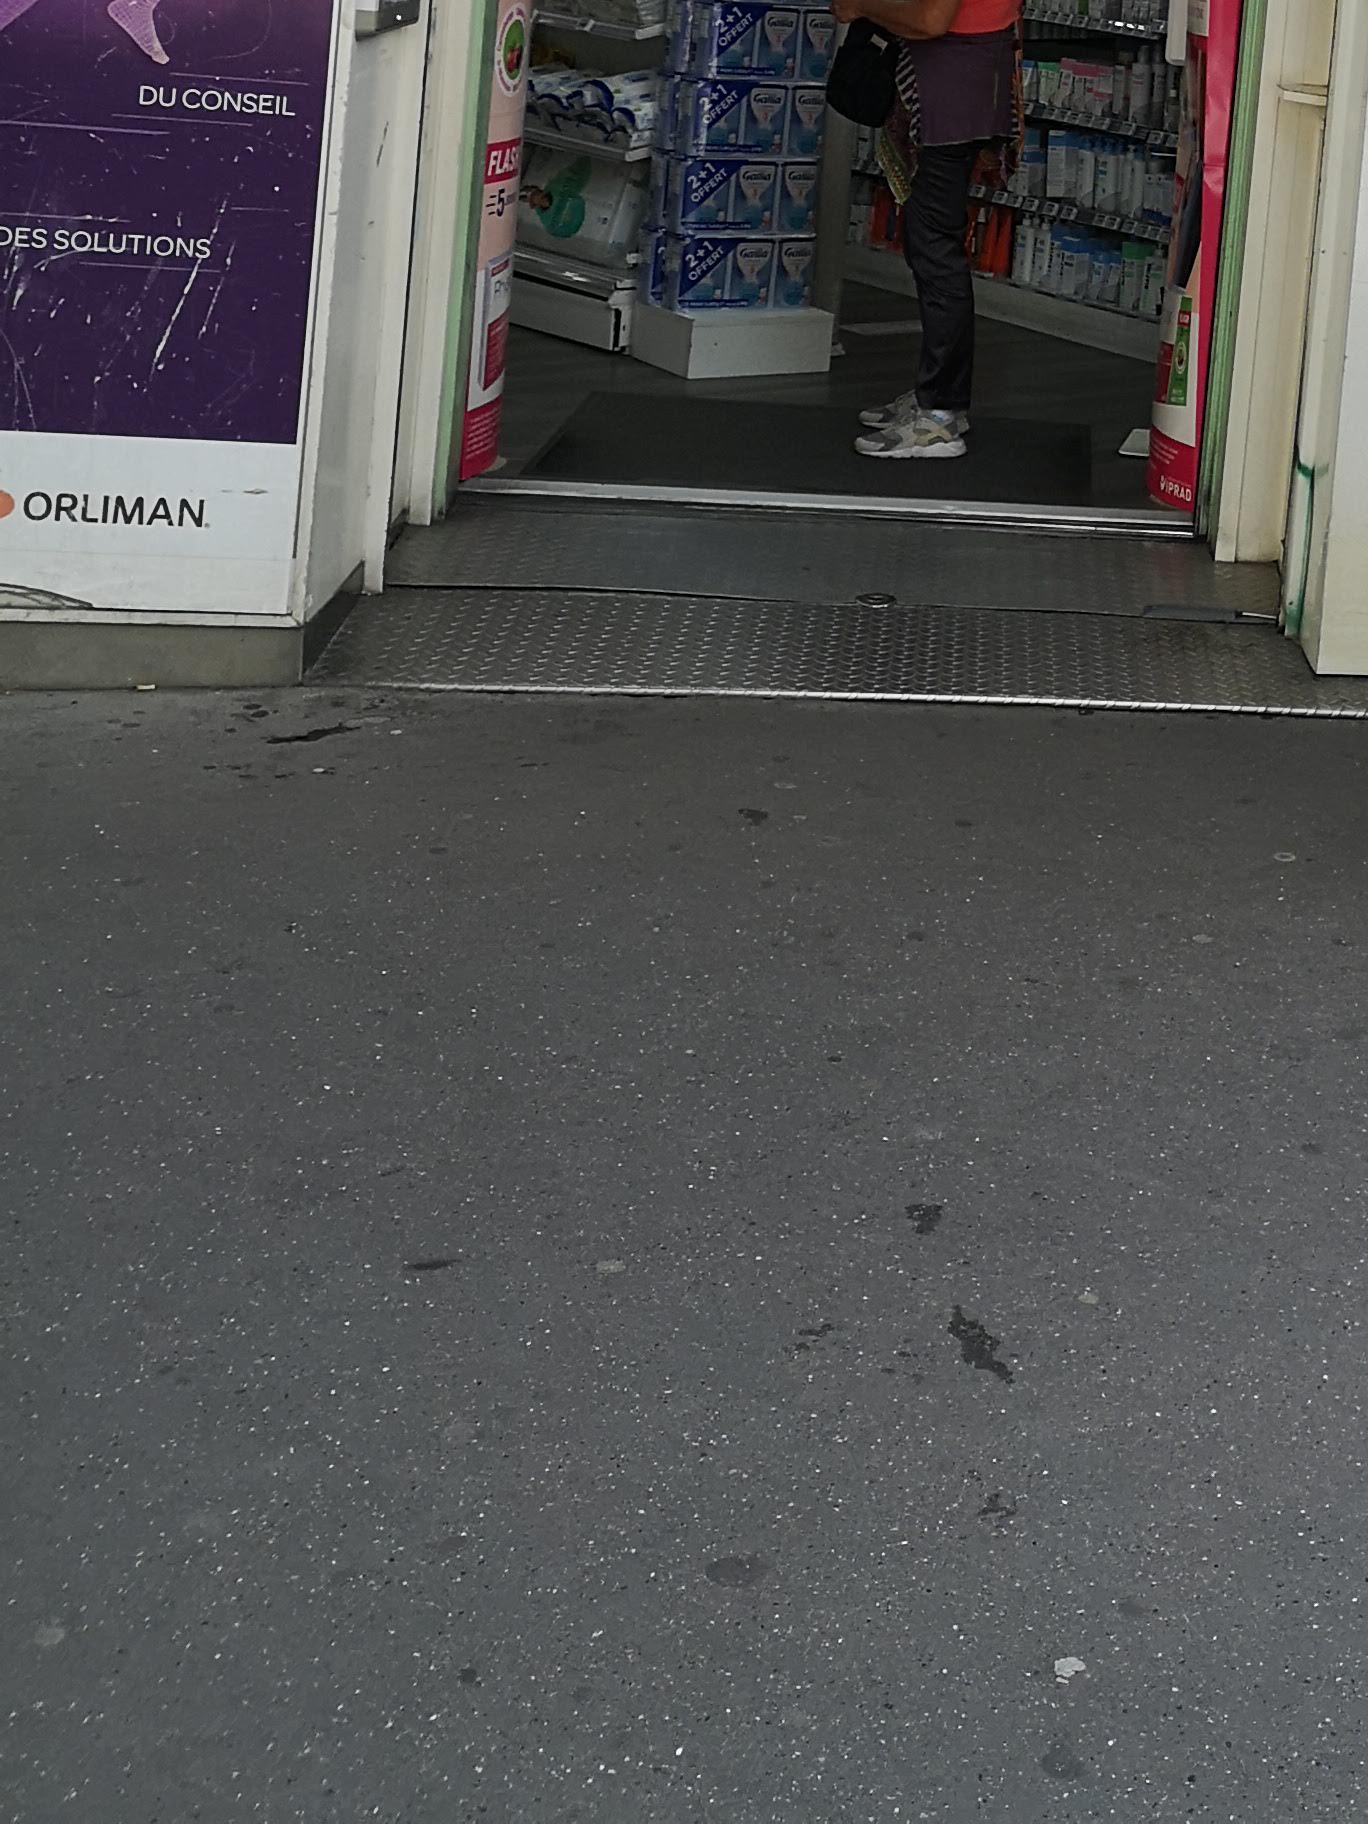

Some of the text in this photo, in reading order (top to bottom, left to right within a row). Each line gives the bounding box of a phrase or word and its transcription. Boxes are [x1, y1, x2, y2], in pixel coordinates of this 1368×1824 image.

[715, 6, 743, 34] 2+1
[718, 13, 753, 47] OFFERT
[139, 85, 296, 117] DU CONSEIL
[699, 84, 728, 111] 2+1
[702, 89, 739, 125] OFFERT
[687, 162, 716, 189] 2+1
[690, 167, 728, 203] OFFERT
[54, 229, 211, 259] SOLUTIONS
[685, 240, 714, 268] 2+1
[688, 246, 725, 281] OFFERT
[24, 491, 205, 528] ORLIMAN
